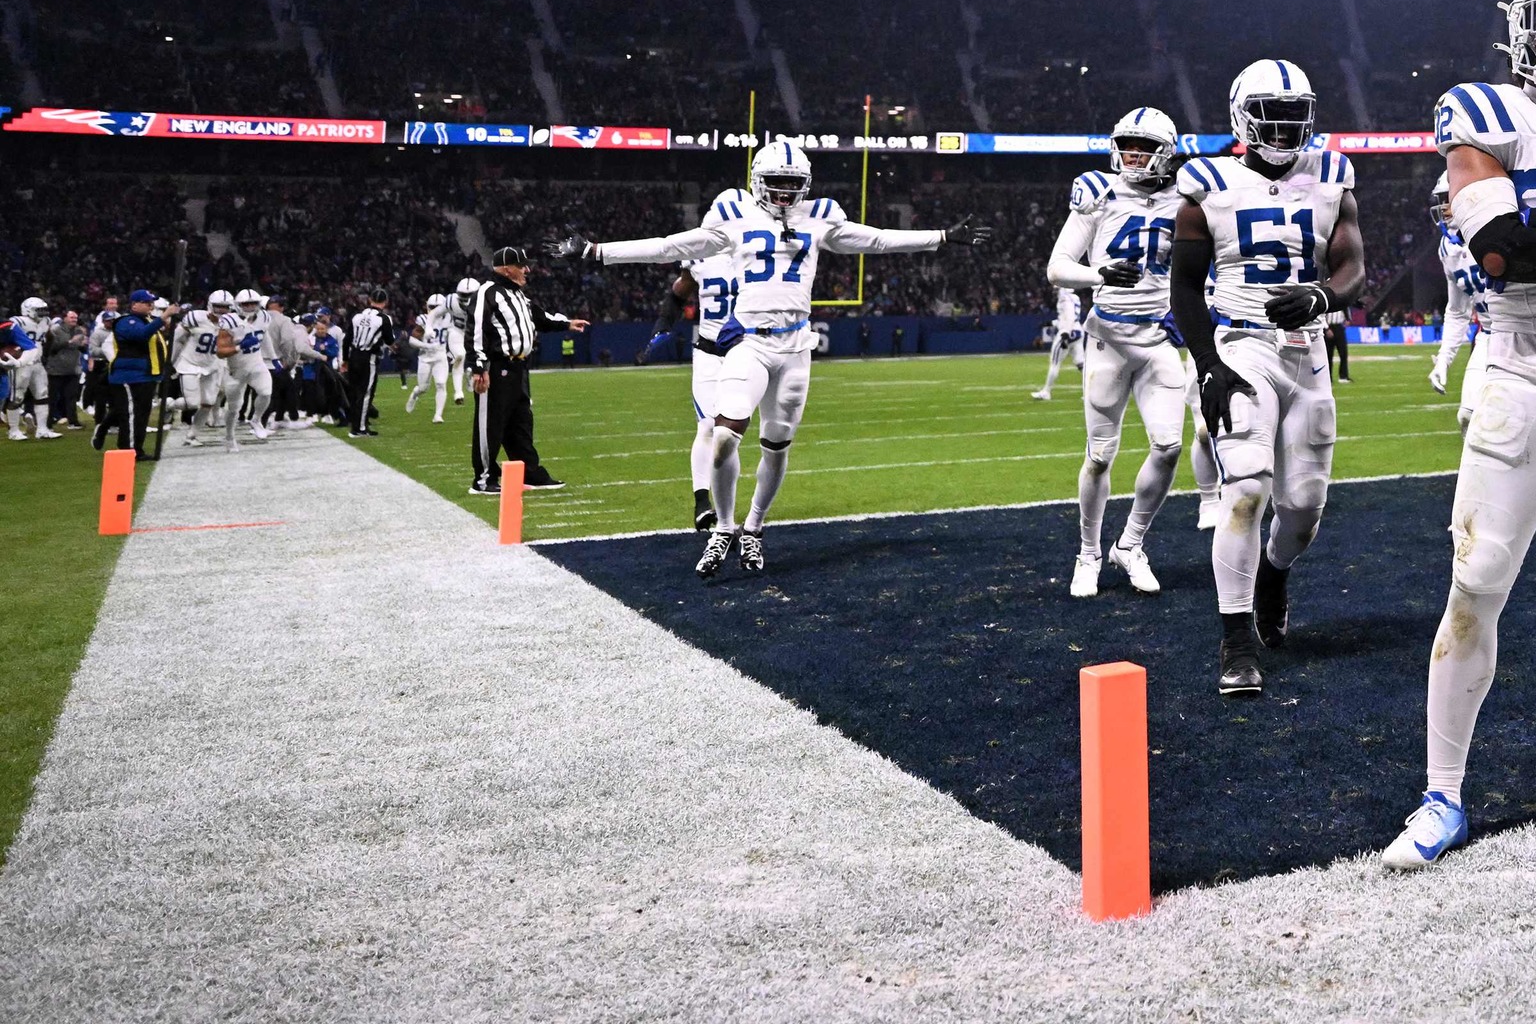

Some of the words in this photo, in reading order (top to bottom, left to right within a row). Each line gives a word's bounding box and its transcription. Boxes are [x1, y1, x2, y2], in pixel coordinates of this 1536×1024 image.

[171, 119, 211, 134] NEW
[213, 121, 292, 136] ENGLAND
[298, 123, 374, 139] PATRIOTS
[466, 127, 488, 142] 10
[611, 130, 623, 145] 6
[698, 133, 710, 147] 4
[1106, 215, 1176, 275] 40
[1235, 207, 1319, 284] 51
[743, 230, 812, 284] 37
